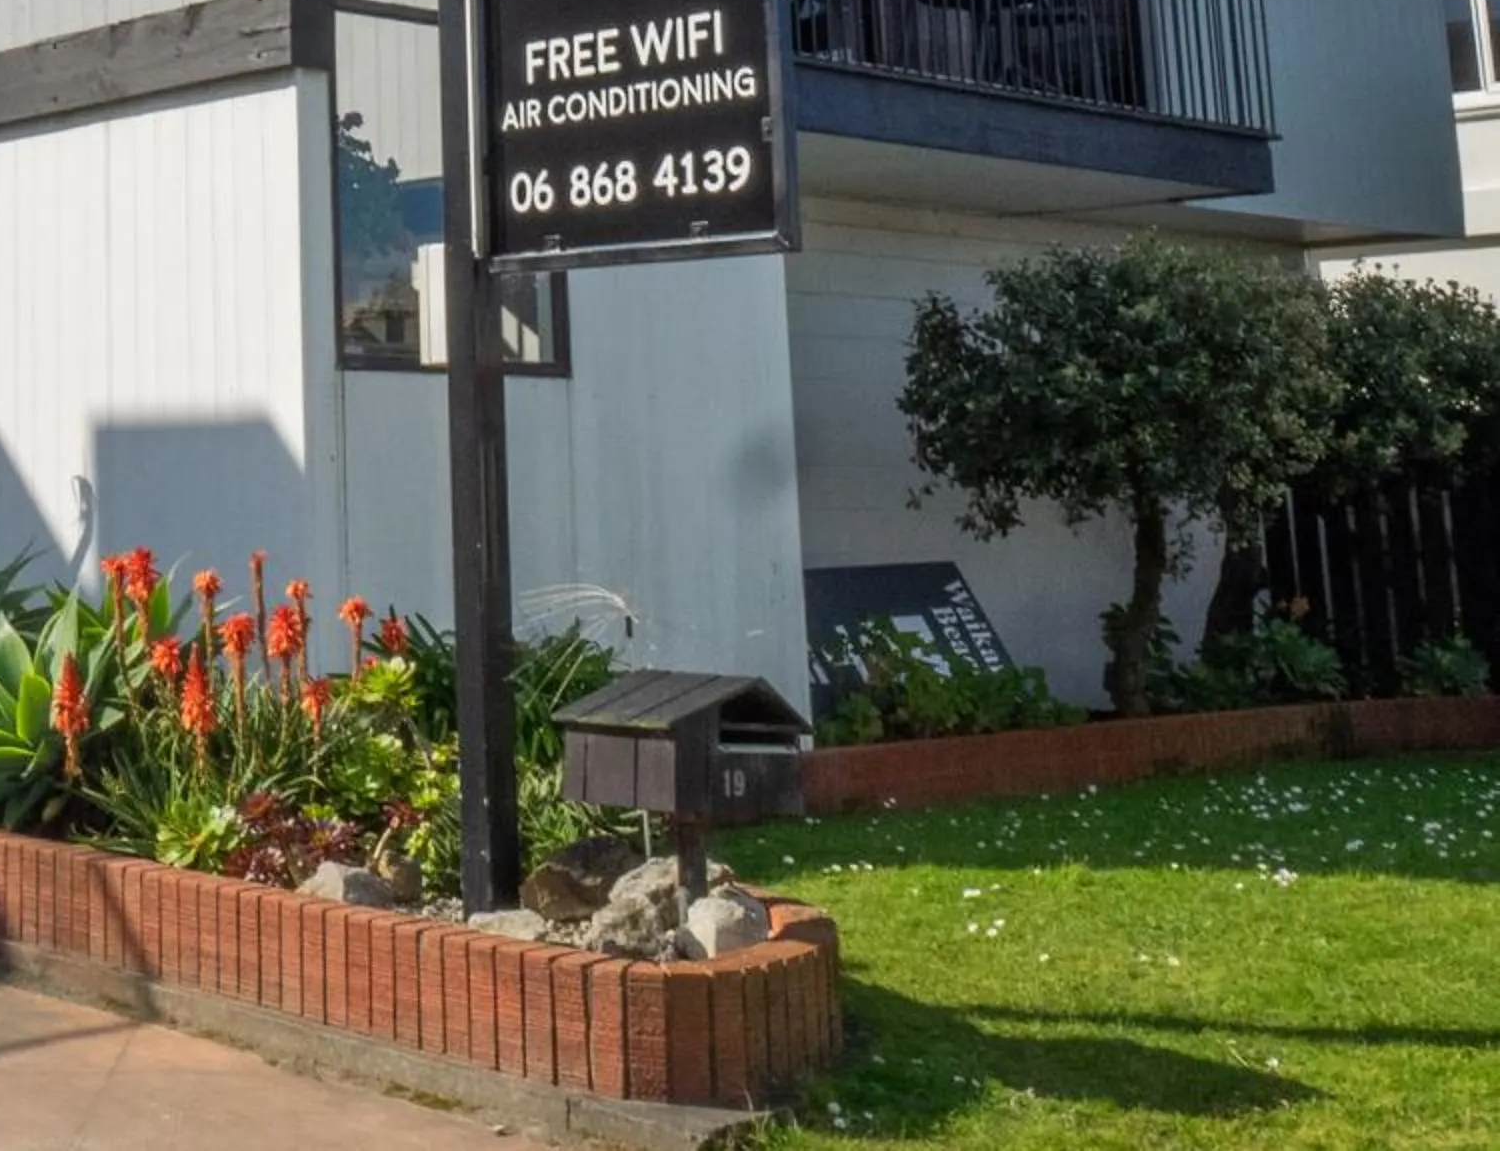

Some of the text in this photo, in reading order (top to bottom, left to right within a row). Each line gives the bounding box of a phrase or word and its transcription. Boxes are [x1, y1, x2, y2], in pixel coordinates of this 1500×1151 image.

[525, 10, 723, 85] FREE WIFI
[502, 67, 757, 132] AIR CONDITIONING
[510, 146, 752, 213] 06 868 4139
[723, 769, 746, 798] 19
